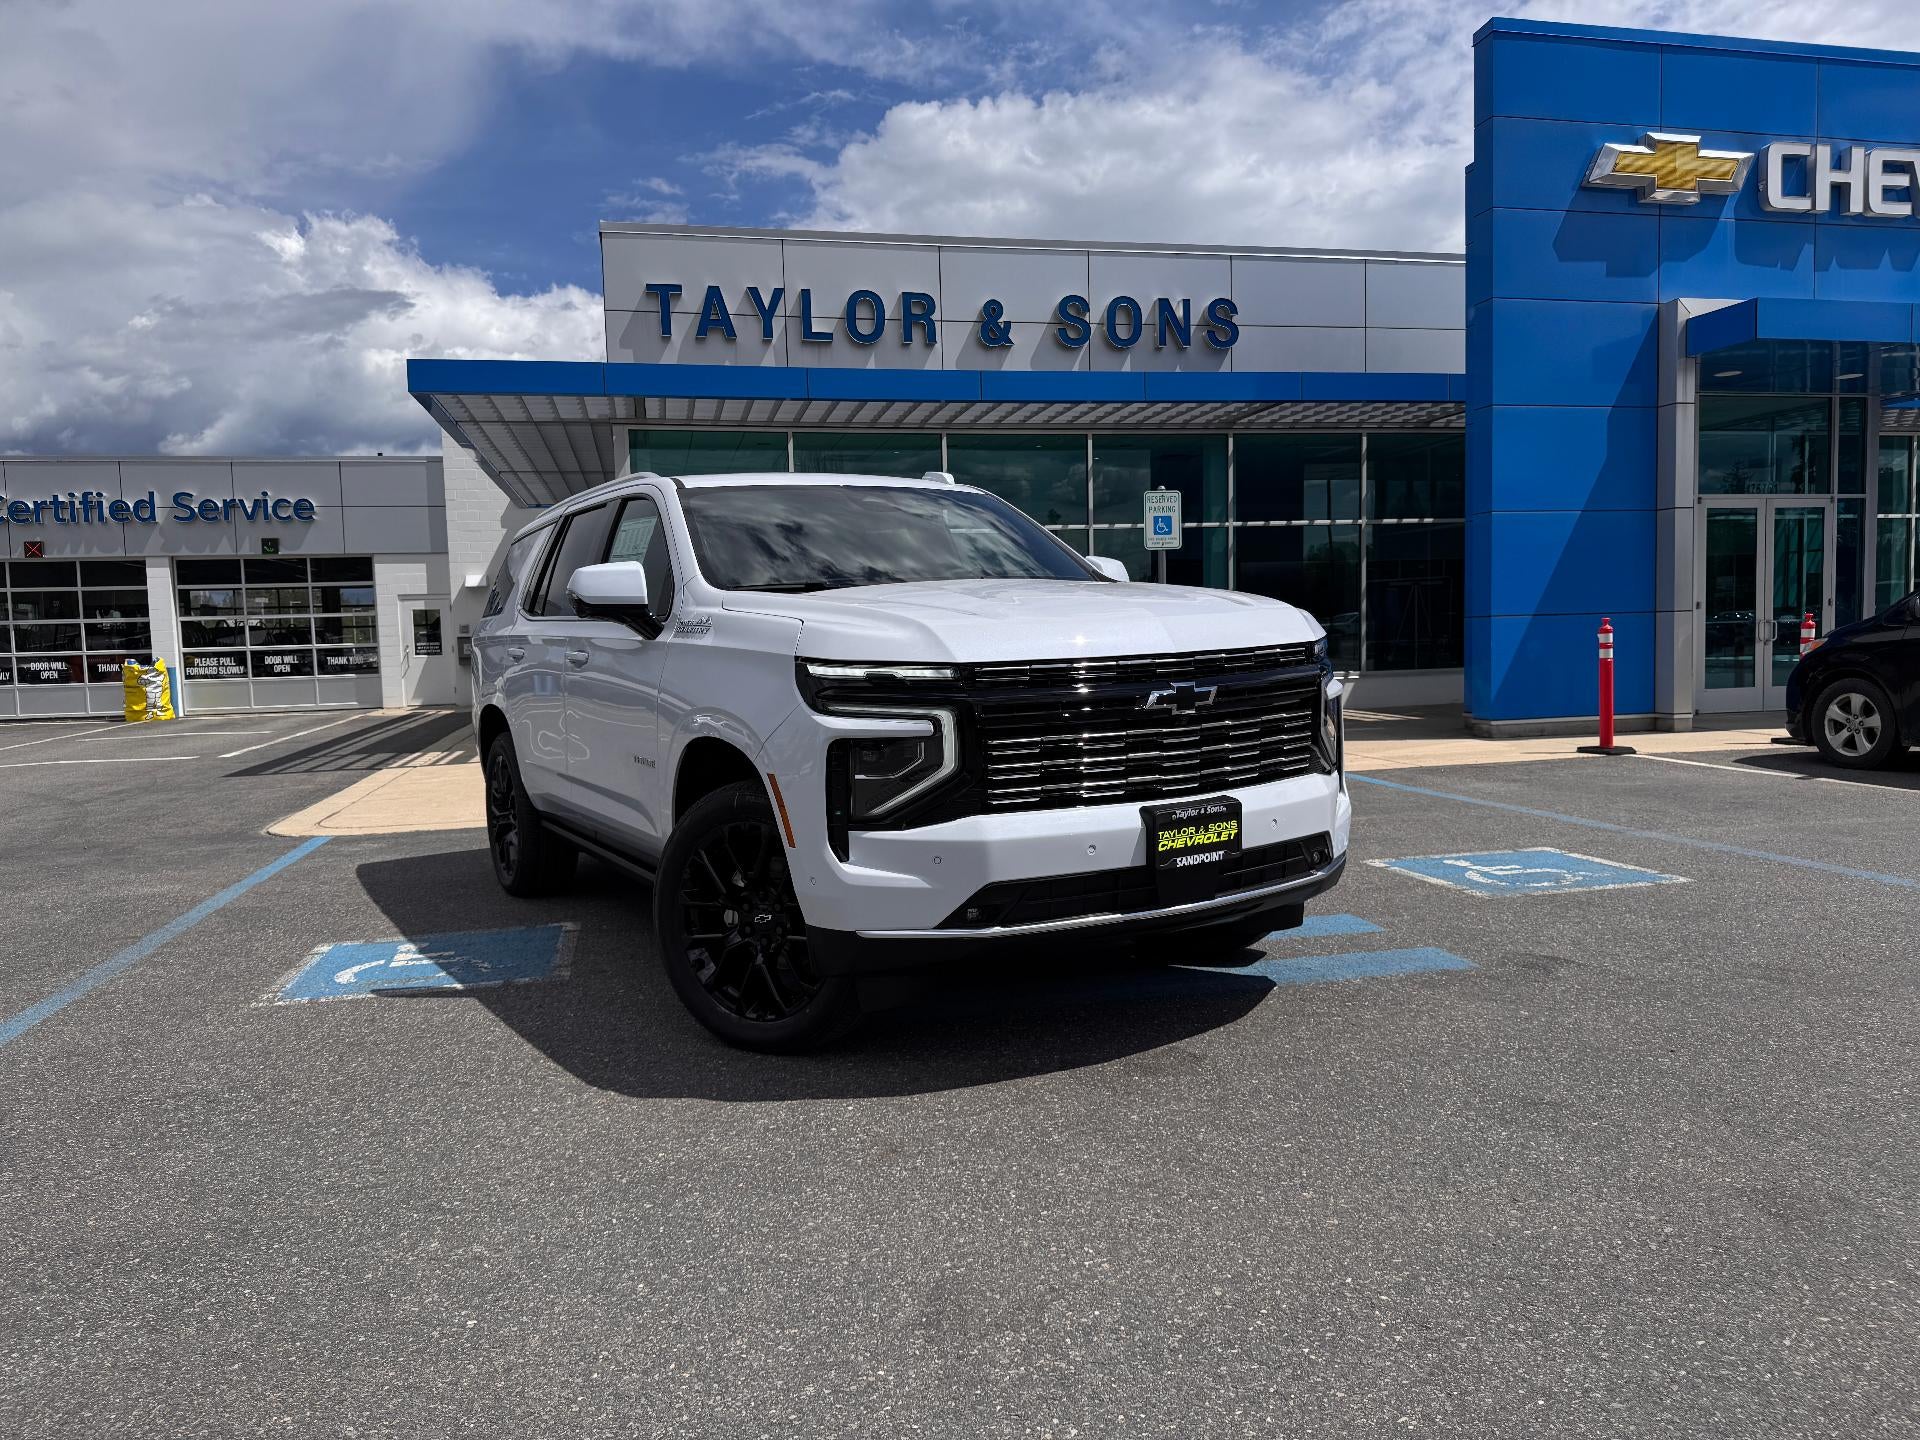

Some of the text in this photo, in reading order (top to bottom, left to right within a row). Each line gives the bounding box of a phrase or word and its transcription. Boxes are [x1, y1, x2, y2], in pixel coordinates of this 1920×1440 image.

[1758, 142, 1920, 217] CHE
[646, 284, 1240, 349] TAYLOR & SONS
[1147, 495, 1177, 504] RESERVED
[172, 491, 316, 522] Service
[194, 657, 236, 667] PLEASE PULL
[264, 655, 299, 664] DOOR WILL
[326, 656, 348, 665] THANK
[30, 662, 67, 670] DOOR WILL
[97, 664, 120, 672] THANK
[186, 666, 244, 675] FORWARD SLOWLY
[273, 664, 290, 672] OPEN
[40, 671, 58, 679] OPEN
[1176, 808, 1199, 819] Taylor
[1206, 804, 1223, 814] Sons
[1158, 820, 1238, 840] TAYLOR & SONS
[1158, 829, 1238, 852] CHEVROLET
[1176, 850, 1225, 868] SANDPOINT
